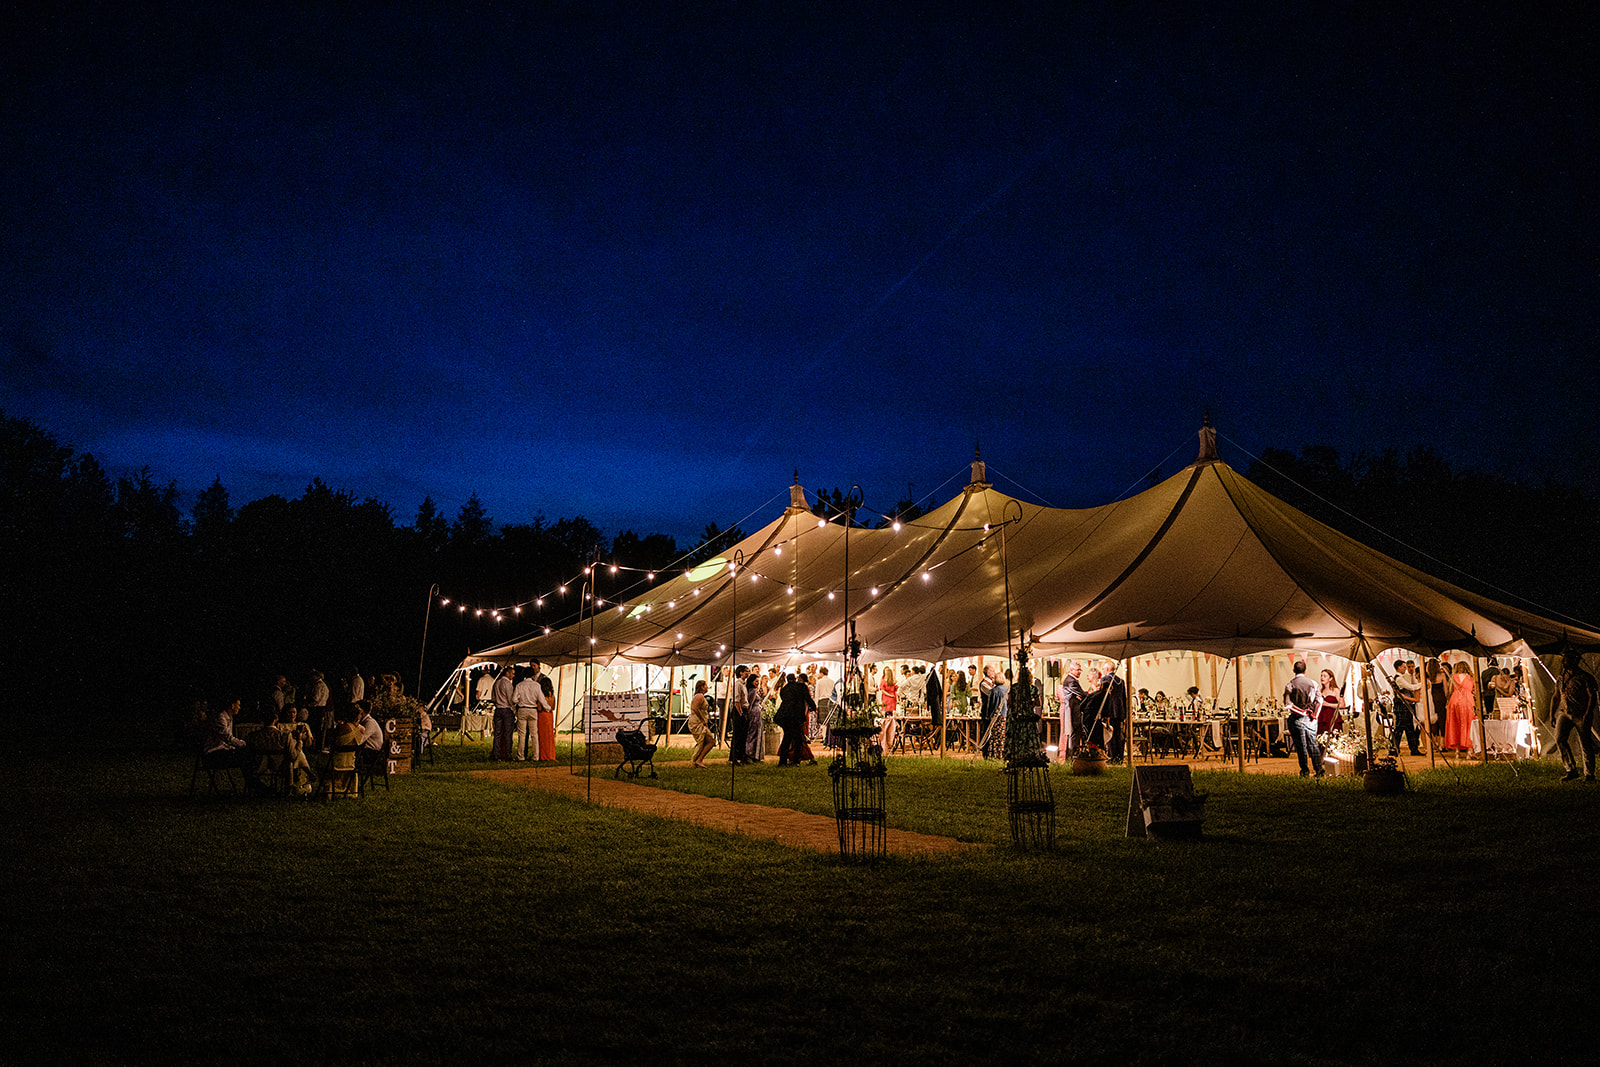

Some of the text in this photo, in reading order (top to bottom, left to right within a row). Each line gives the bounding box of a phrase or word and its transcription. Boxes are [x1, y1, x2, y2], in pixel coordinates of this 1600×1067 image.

[386, 720, 401, 774] C & T
